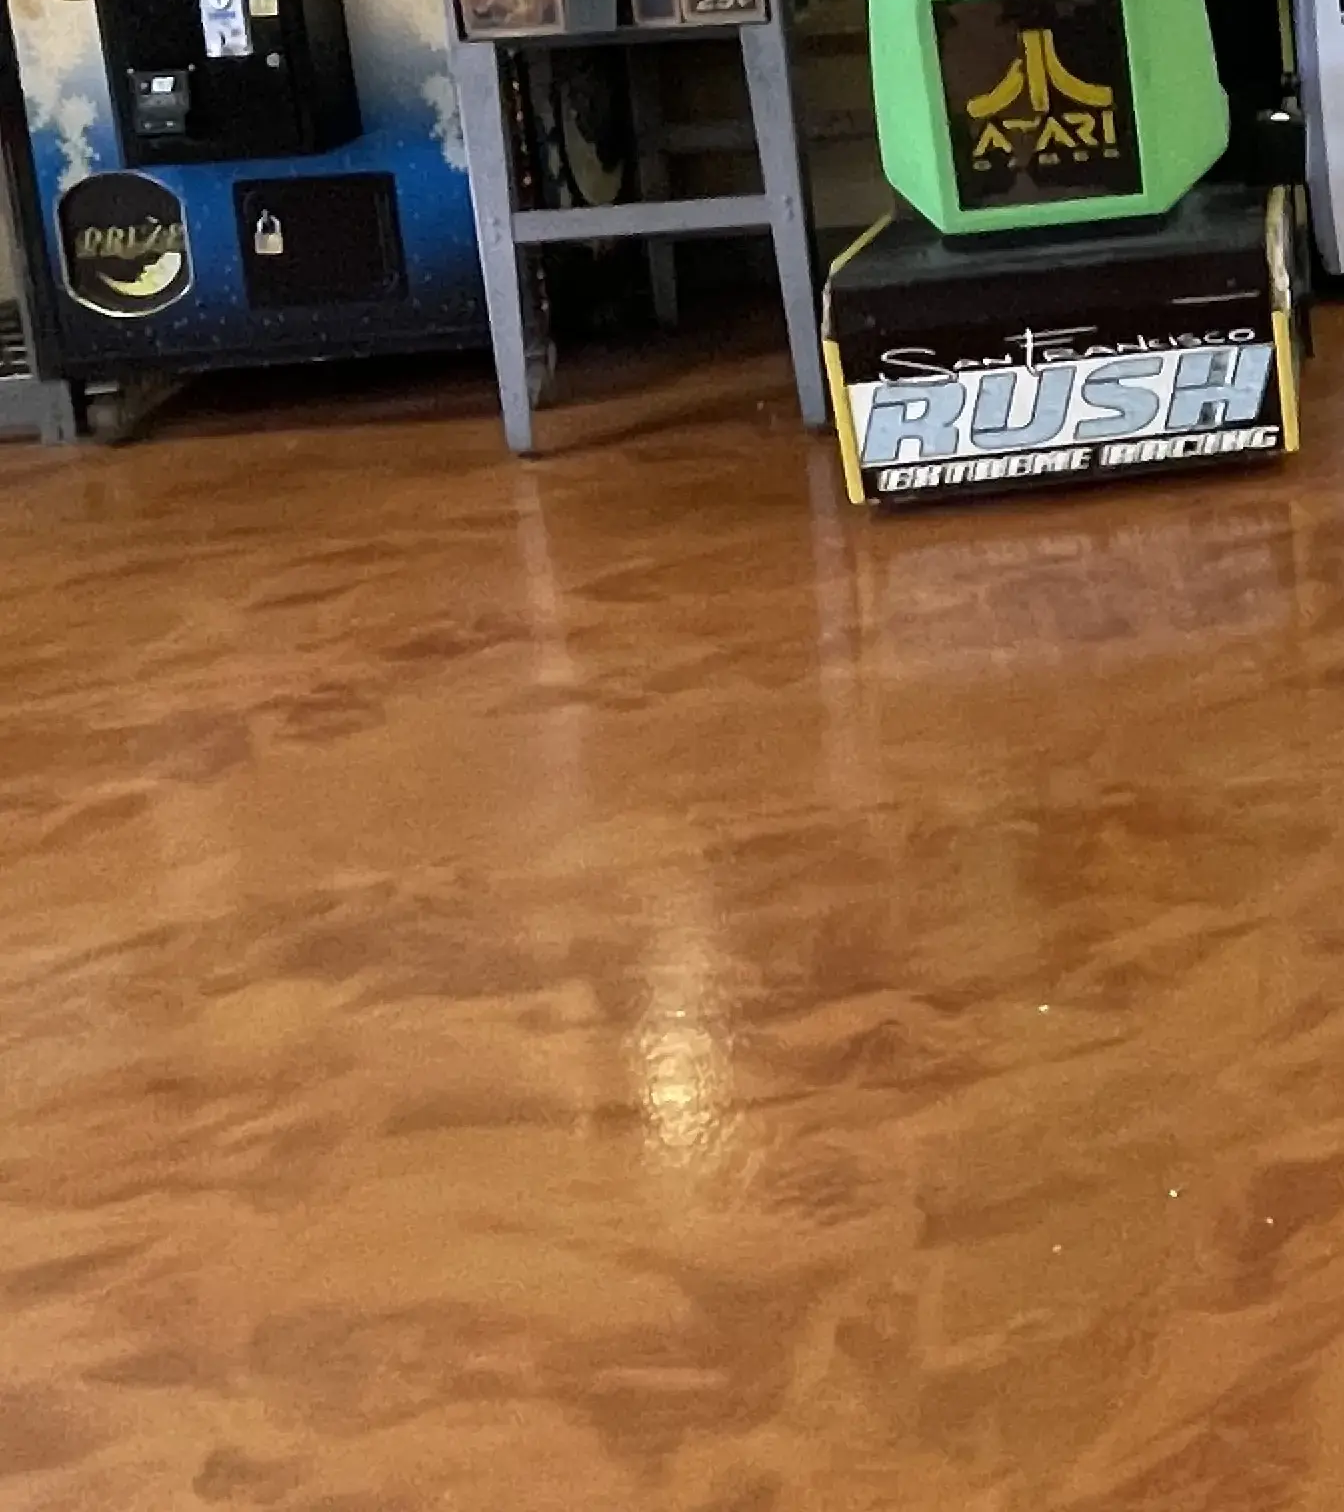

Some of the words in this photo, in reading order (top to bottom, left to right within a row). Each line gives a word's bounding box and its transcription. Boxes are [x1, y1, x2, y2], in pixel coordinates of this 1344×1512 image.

[972, 109, 1120, 157] ATARI
[879, 346, 1012, 384] San
[1003, 326, 1256, 377] Francisco
[863, 341, 1274, 464] RUSH
[877, 445, 1093, 492] EXTREME
[1099, 424, 1281, 468] RACING
